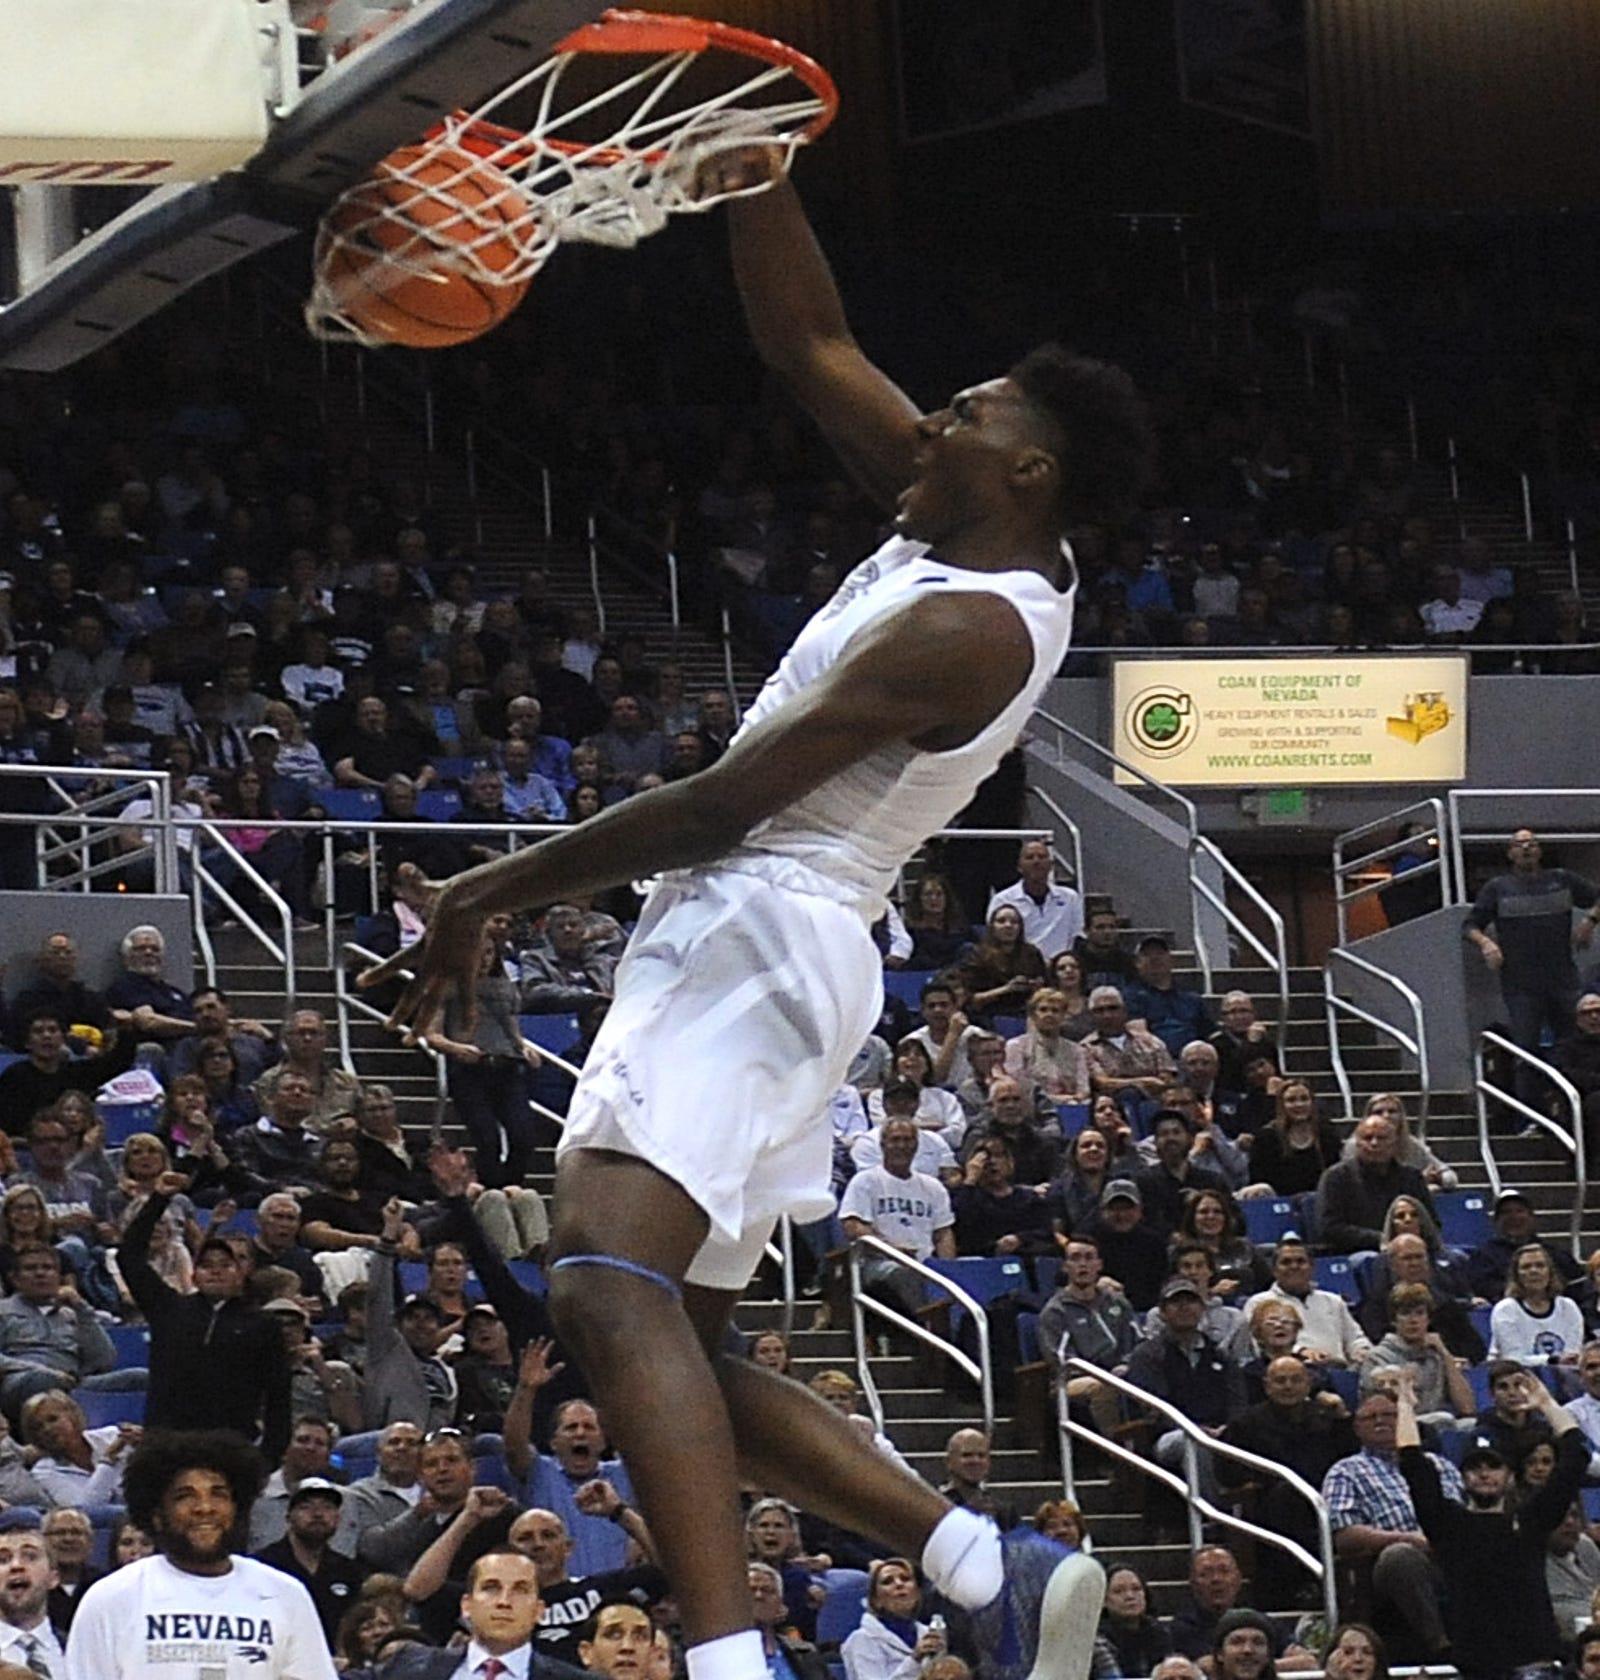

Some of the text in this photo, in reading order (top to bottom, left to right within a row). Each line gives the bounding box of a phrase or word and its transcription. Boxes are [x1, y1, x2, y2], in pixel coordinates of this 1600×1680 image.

[1218, 675, 1362, 688] COAN EQUIPMENT OF
[1262, 689, 1318, 702] NEVADA
[1271, 739, 1329, 749] COMMUNITY
[1208, 753, 1372, 768] WWW.COANRENTS.COM
[146, 1614, 274, 1645] NEVADA
